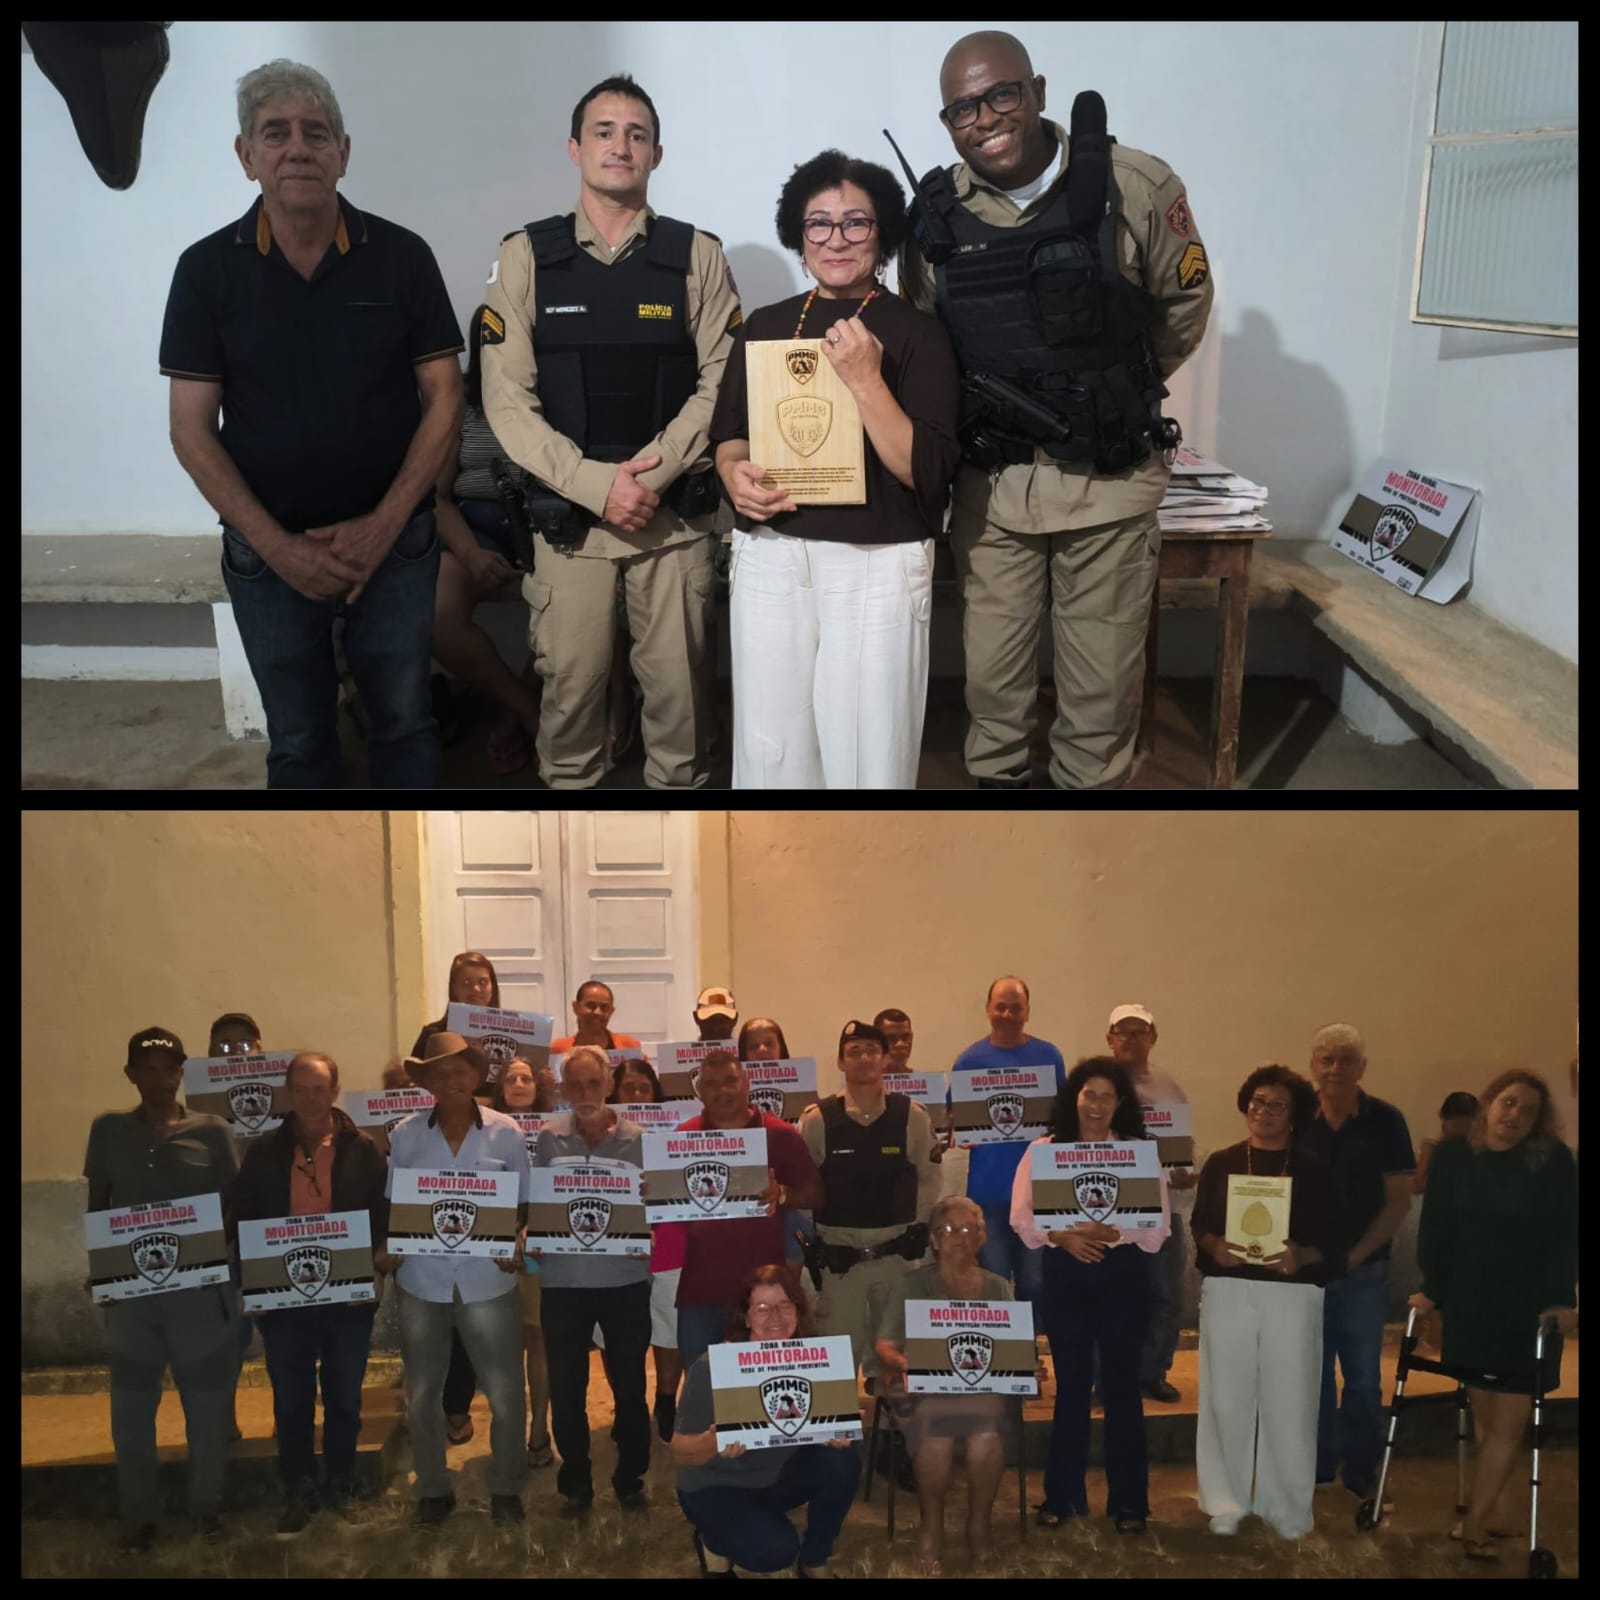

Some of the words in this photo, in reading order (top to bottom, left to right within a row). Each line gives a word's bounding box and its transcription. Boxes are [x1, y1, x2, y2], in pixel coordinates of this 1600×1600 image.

[788, 352, 816, 361] PMMG
[1385, 470, 1449, 509] MONITORADA
[1382, 507, 1415, 532] PMMG
[207, 1059, 287, 1076] MONITORADA
[971, 1073, 1037, 1086] MONITORADA
[229, 1084, 270, 1100] PMMG
[368, 1096, 434, 1110] MONITORAD
[988, 1095, 1022, 1108] PMMG
[666, 1137, 744, 1152] MONITORADA
[1055, 1149, 1135, 1162] MONITORADA
[687, 1163, 726, 1178] PMMG
[417, 1176, 496, 1190] MONITORADA
[553, 1175, 630, 1187] MONITORADA
[1075, 1174, 1116, 1188] PMMG
[434, 1201, 474, 1215] PMMG
[570, 1200, 609, 1213] PMMG
[109, 1204, 195, 1228] MONITORADA
[264, 1220, 347, 1239] MONITORADA
[132, 1233, 176, 1253] PMMG
[286, 1247, 328, 1265] PMMG
[929, 1308, 1009, 1321] MONITORADA
[760, 1341, 778, 1349] ZONA
[950, 1335, 990, 1349] PMMG
[737, 1346, 828, 1366] MONITORADA
[762, 1378, 808, 1397] PMMG
